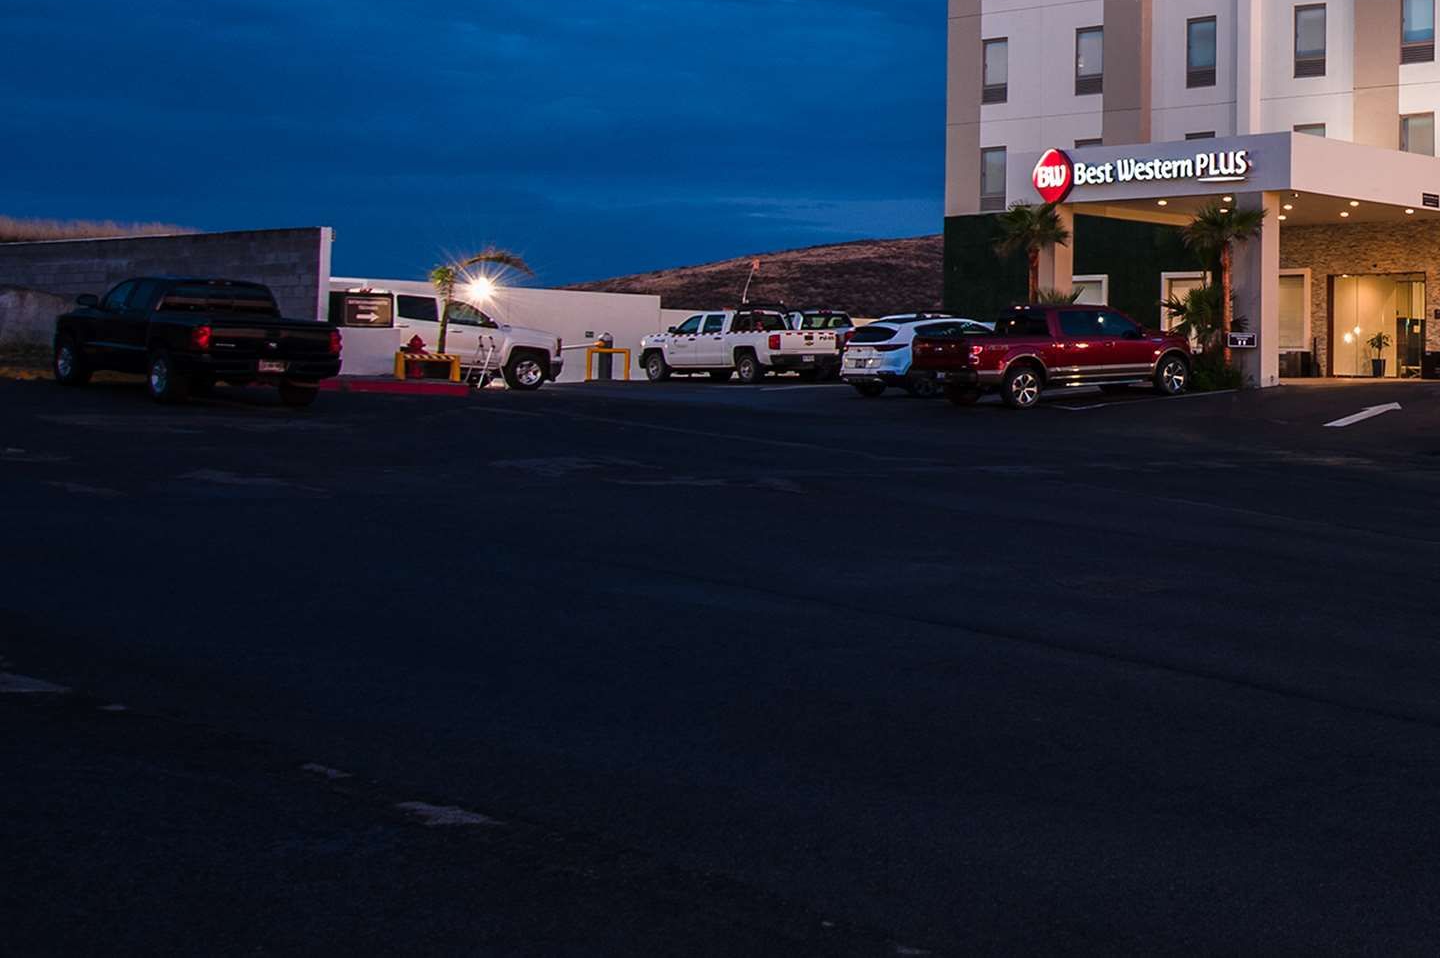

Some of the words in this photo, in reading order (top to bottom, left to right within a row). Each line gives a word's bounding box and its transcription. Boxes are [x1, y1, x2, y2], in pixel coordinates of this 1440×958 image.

[1036, 163, 1067, 189] BW
[1073, 162, 1114, 186] Best
[1116, 157, 1193, 182] Western
[1195, 150, 1249, 177] PLUS
